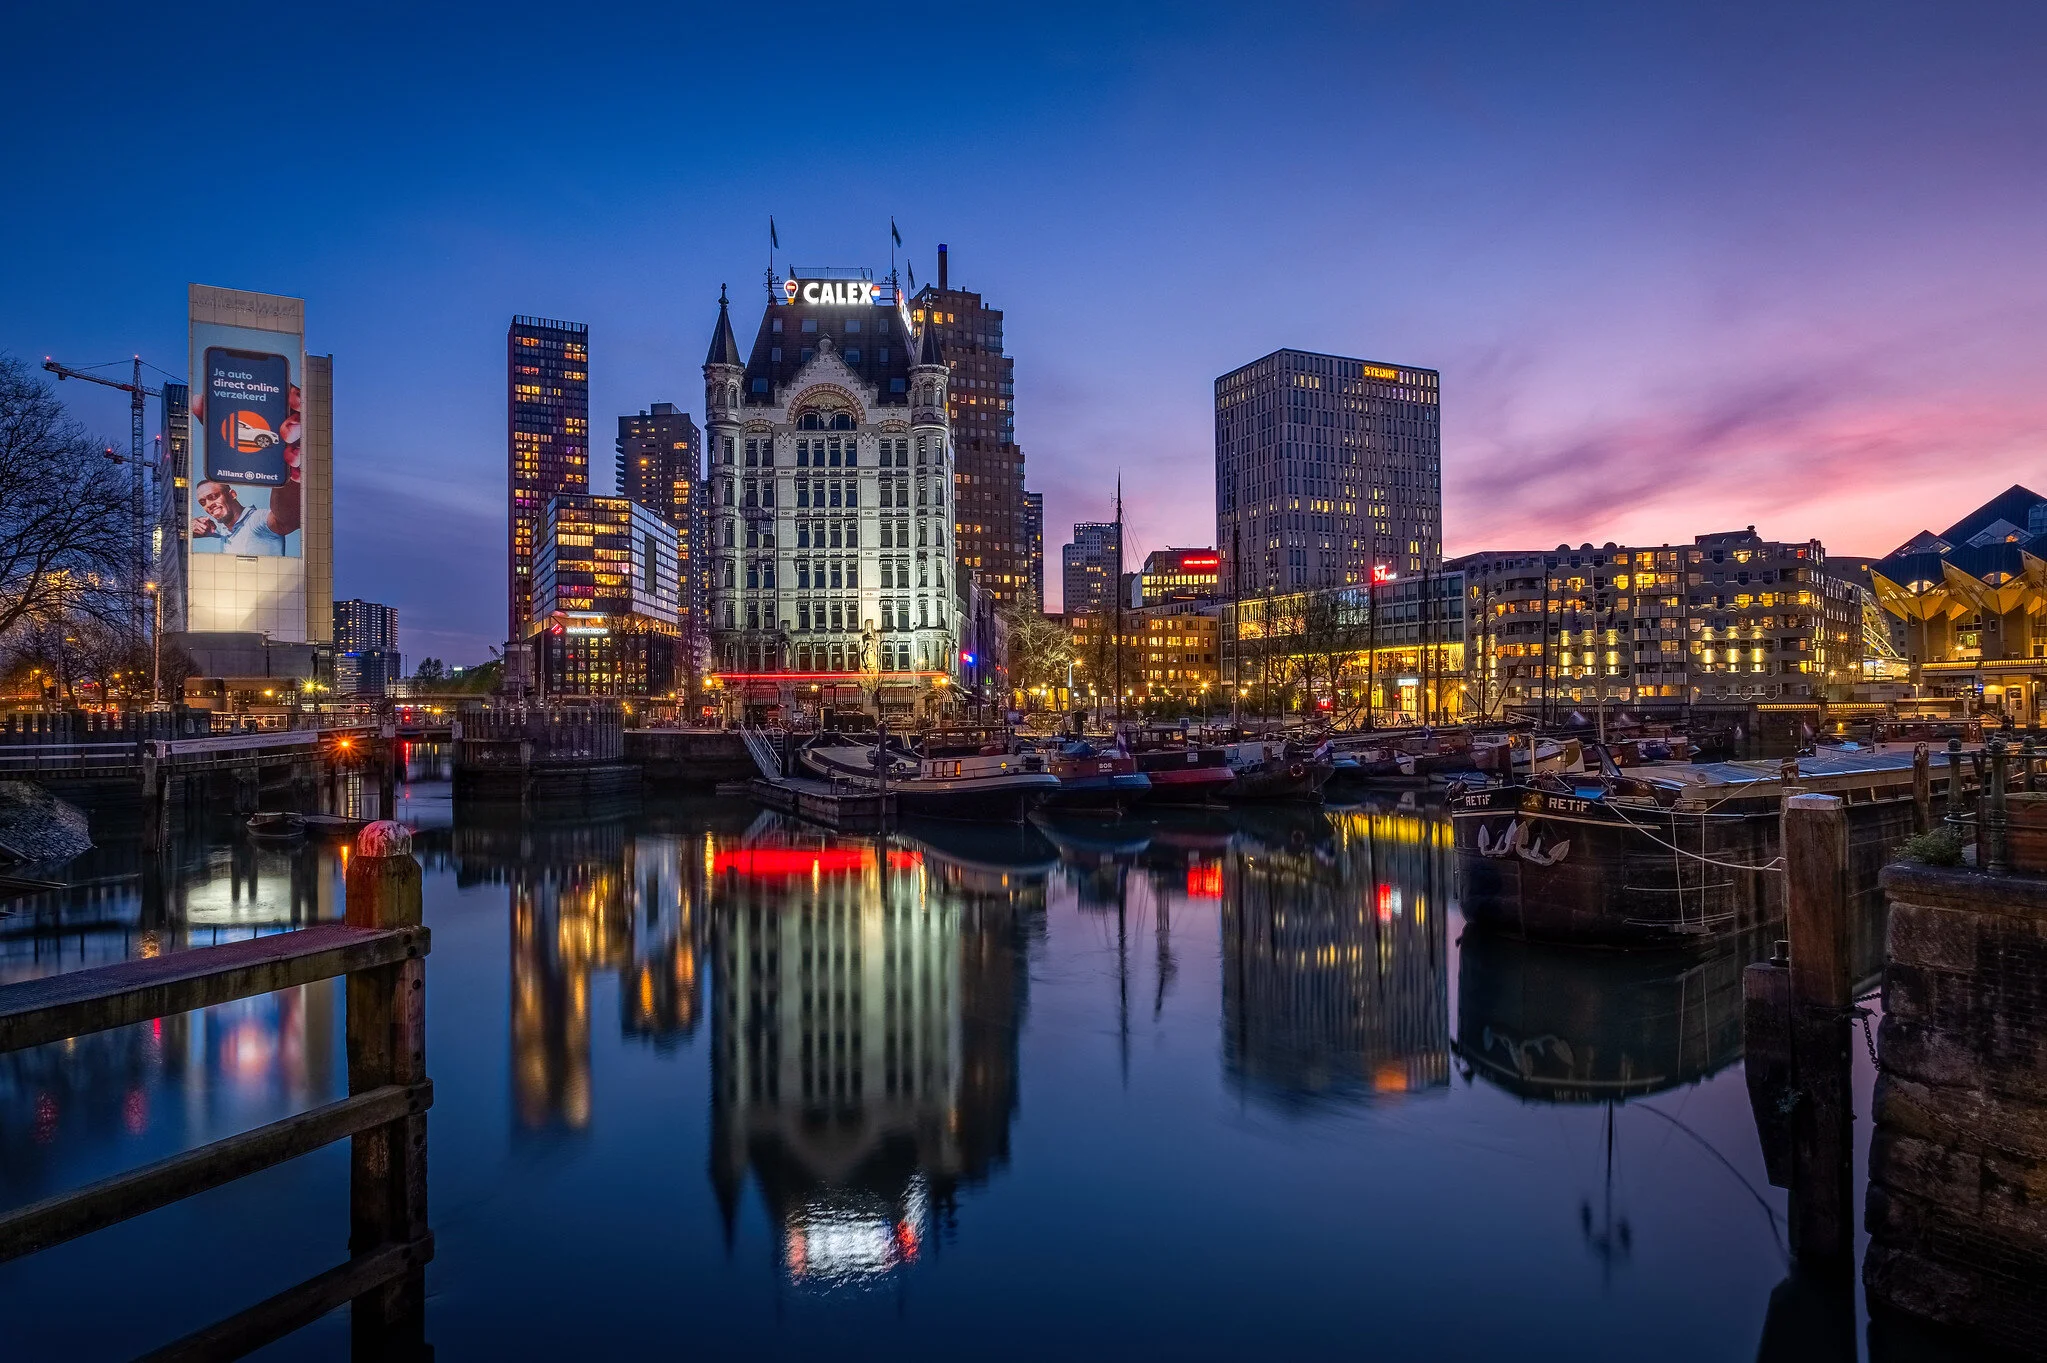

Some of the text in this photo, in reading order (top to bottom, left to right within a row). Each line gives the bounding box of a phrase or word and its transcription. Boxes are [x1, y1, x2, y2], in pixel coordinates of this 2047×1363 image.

[803, 282, 873, 305] CALEX
[214, 368, 253, 380] Je auto
[213, 379, 279, 393] direct online
[213, 390, 267, 402] verzekerd
[217, 469, 278, 481] Allianz Direct
